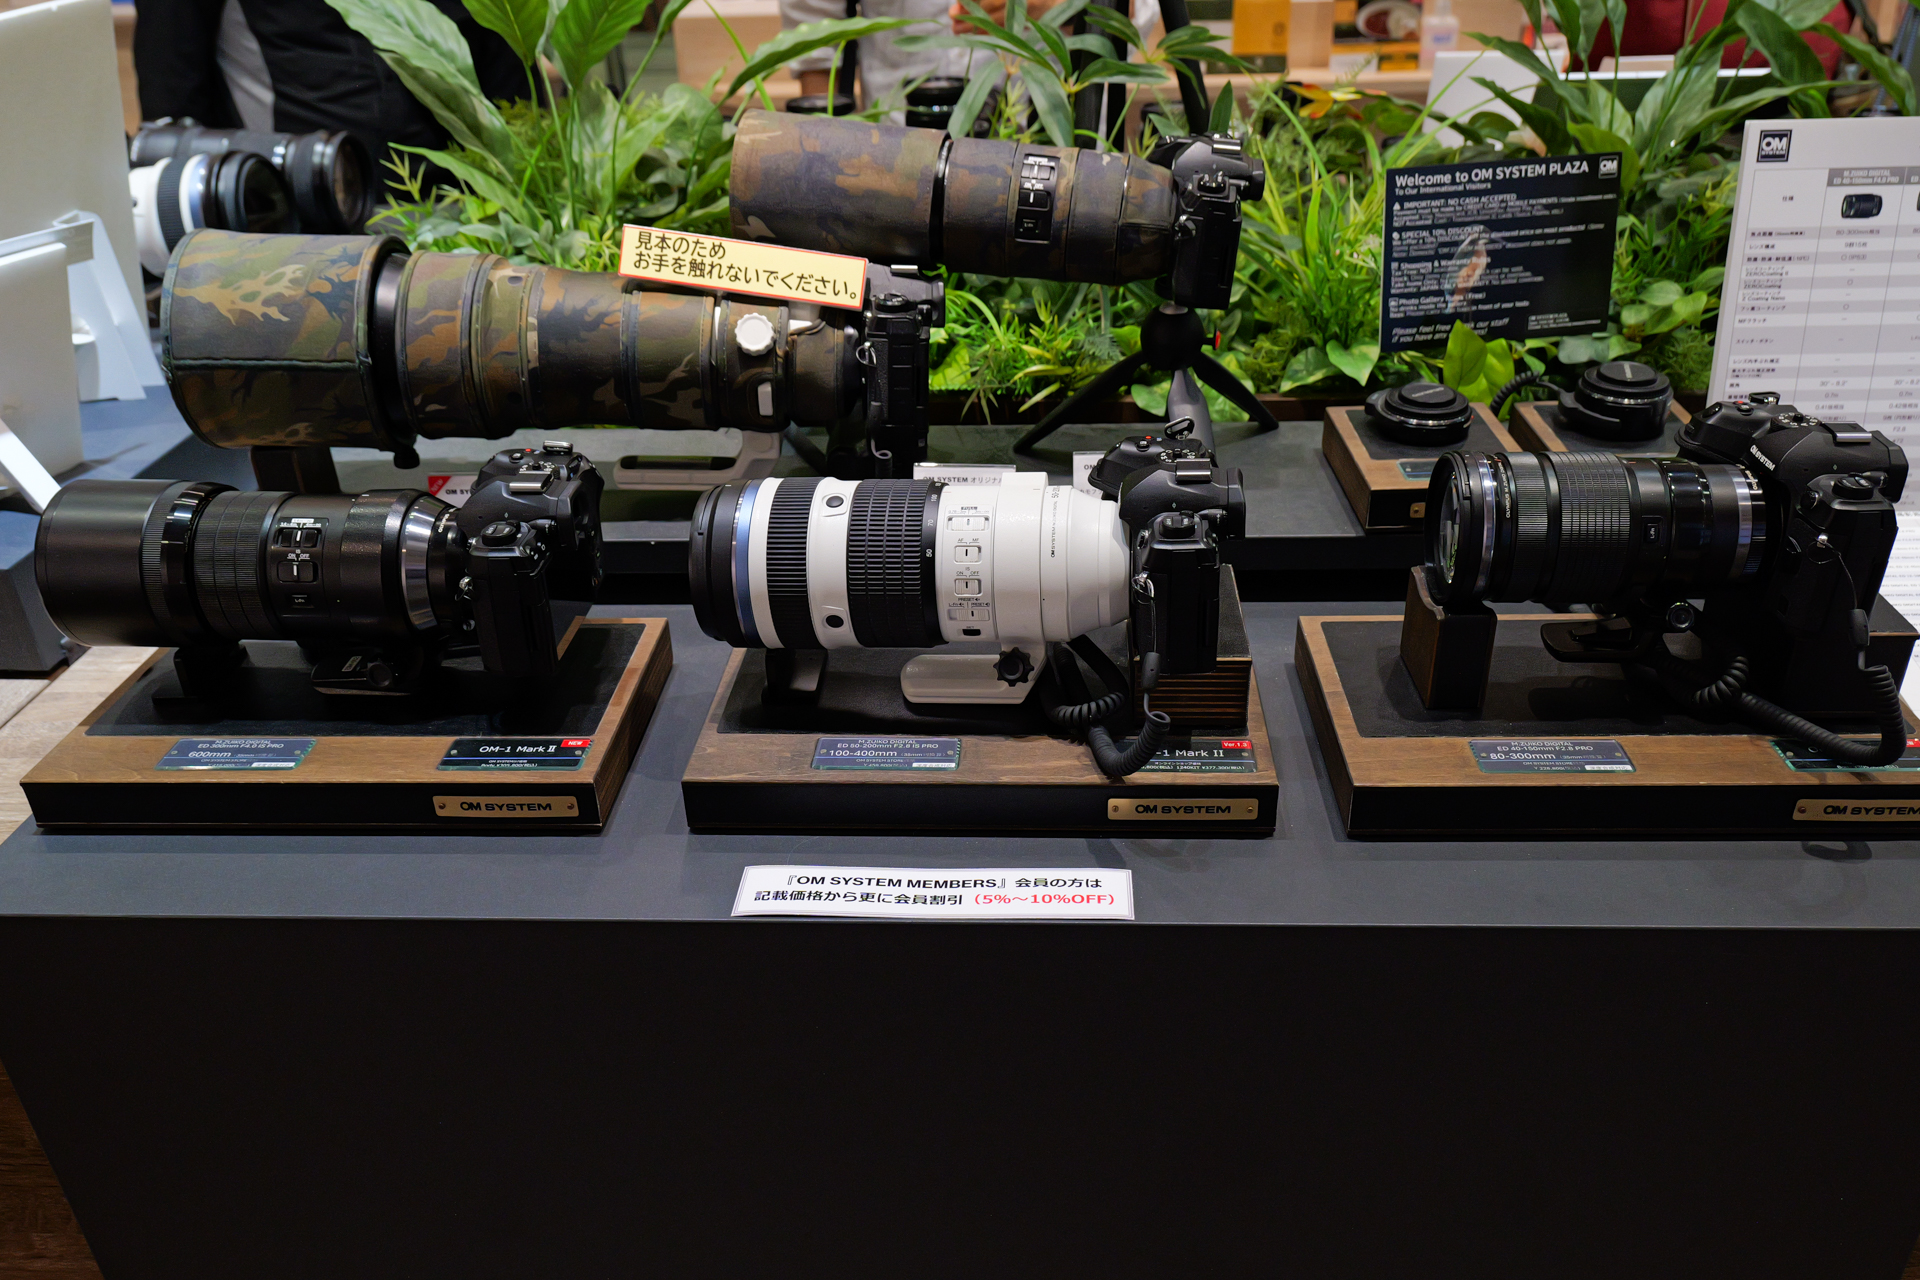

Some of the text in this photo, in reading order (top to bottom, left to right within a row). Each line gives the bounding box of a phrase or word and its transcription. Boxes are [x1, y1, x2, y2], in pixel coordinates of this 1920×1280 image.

[1762, 136, 1787, 150] OM
[1600, 160, 1617, 171] OM
[1395, 160, 1589, 187] Welcome to OM SYSTEM PLAZA
[1868, 169, 1891, 177] DIGITAL
[1395, 182, 1491, 196] To Our International Visitors
[1448, 198, 1458, 206] NO
[1460, 196, 1479, 205] CASH
[1481, 193, 1517, 203] ACCEPTED
[1401, 225, 1484, 240] SPECIAL 10% DISCOUNT
[635, 231, 726, 260] 見本のため
[633, 251, 857, 300] お手を触れないでください。
[431, 478, 444, 492] NEW
[928, 519, 934, 527] 70
[925, 548, 933, 557] 50
[479, 745, 511, 753] OM-1
[1175, 749, 1208, 757] Mark
[459, 801, 552, 812] OM SYSTEM
[1135, 805, 1232, 814] OM SYSTEM
[1823, 805, 1920, 815] OM SYSTEM
[830, 877, 906, 888] SYSTEM
[1015, 877, 1103, 888] 会員の方は
[754, 890, 963, 905] 記載価格から更に会員割引
